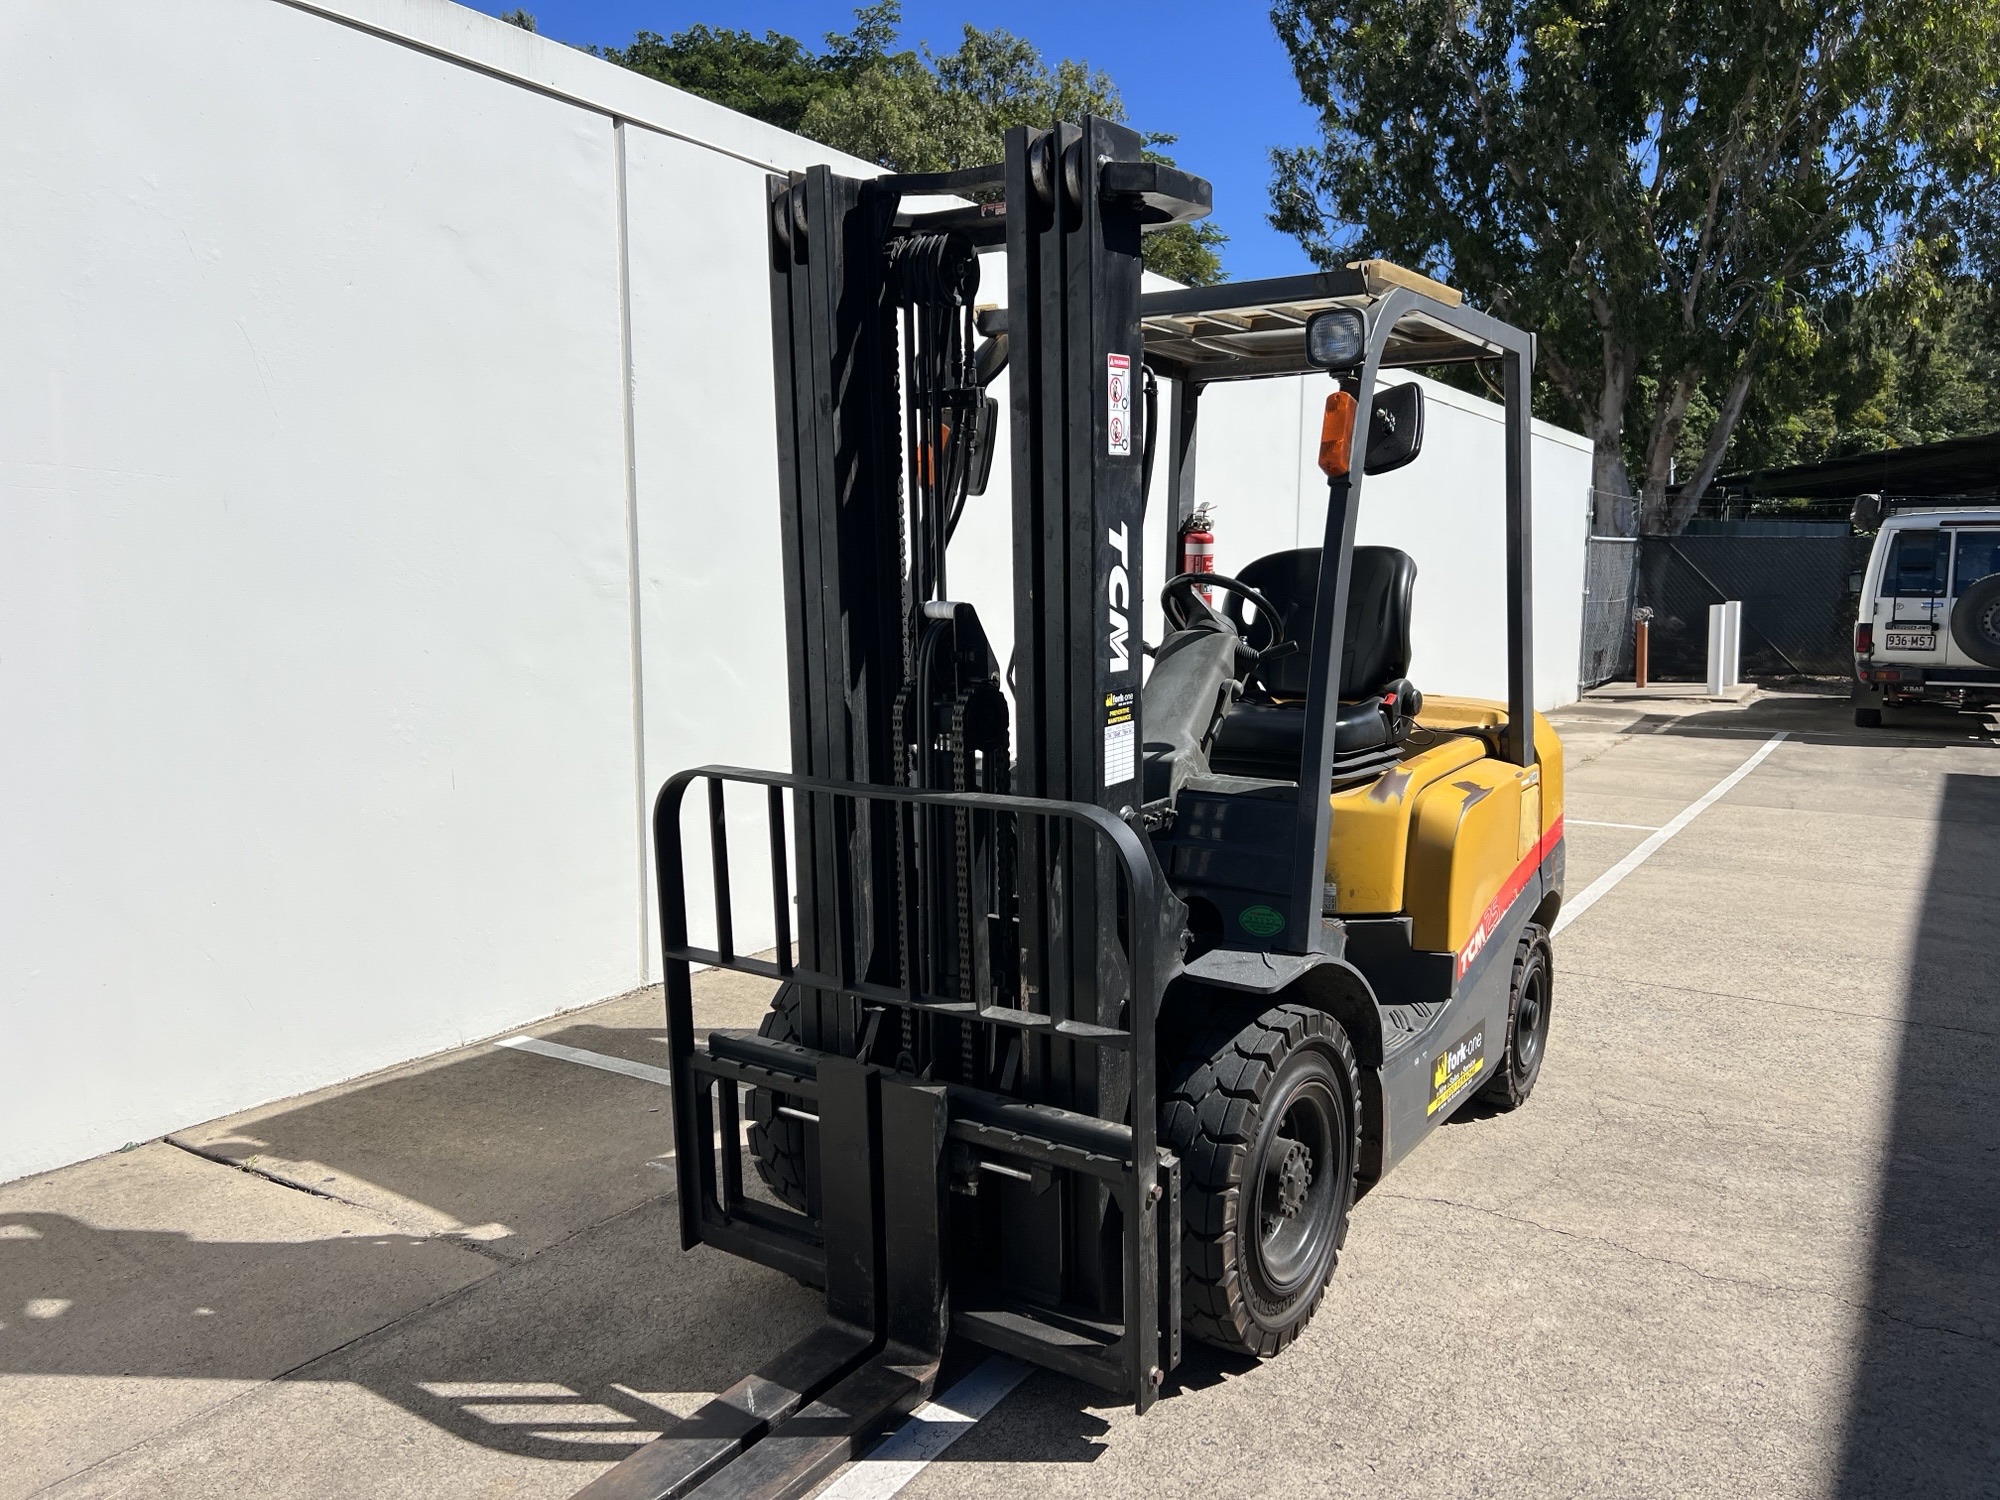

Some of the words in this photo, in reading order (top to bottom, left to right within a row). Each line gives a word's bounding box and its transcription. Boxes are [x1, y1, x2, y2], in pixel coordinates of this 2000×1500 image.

[1108, 520, 1129, 673] TCM
[1460, 923, 1486, 974] TCM
[1483, 895, 1501, 938] 25
